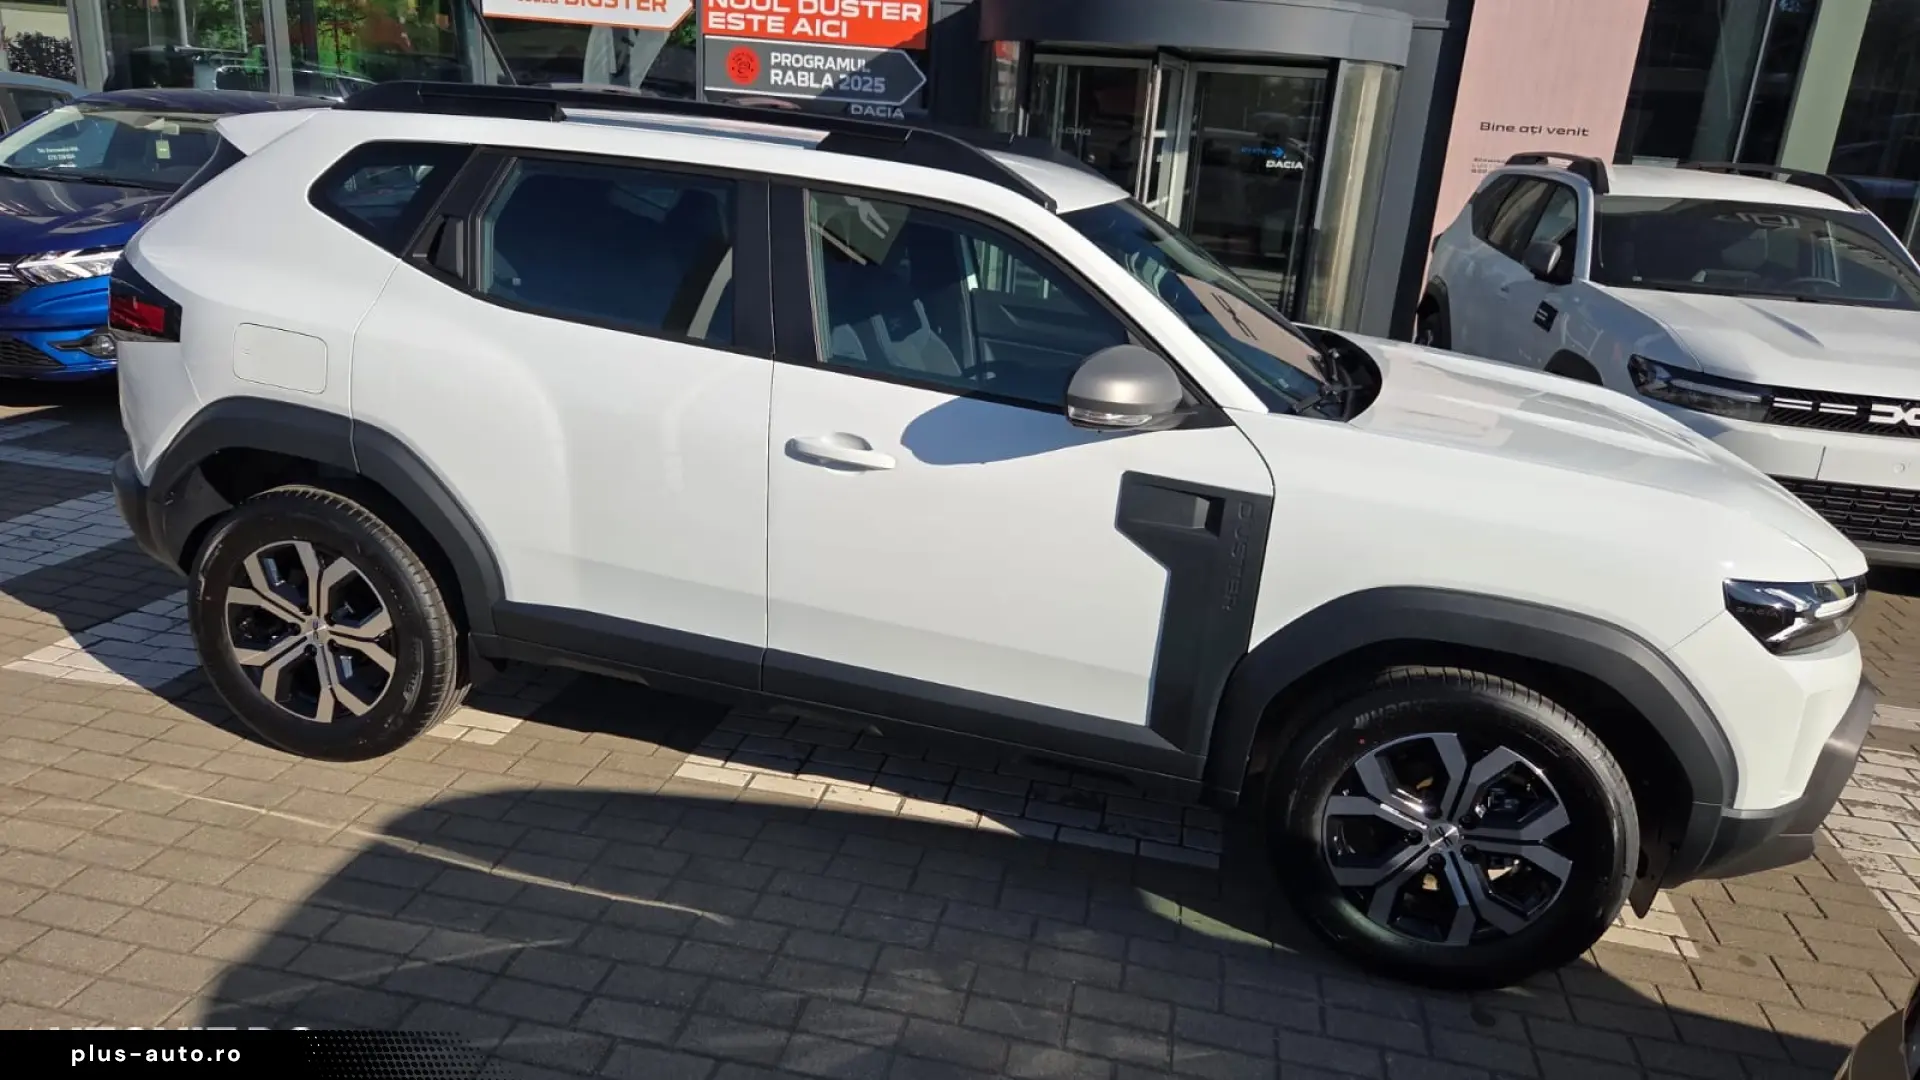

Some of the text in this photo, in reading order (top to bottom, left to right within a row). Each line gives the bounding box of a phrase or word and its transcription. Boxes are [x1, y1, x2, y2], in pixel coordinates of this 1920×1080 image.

[797, 0, 922, 21] DUSTER
[708, 12, 847, 38] ESTE AICI
[769, 52, 871, 73] PROGRAMUL
[769, 69, 886, 93] RABLA 2025
[851, 104, 905, 119] DACIA
[1480, 121, 1516, 133] Bine
[1547, 127, 1590, 137] venit
[1265, 160, 1304, 169] DACIA
[1222, 500, 1254, 611] DUSTER
